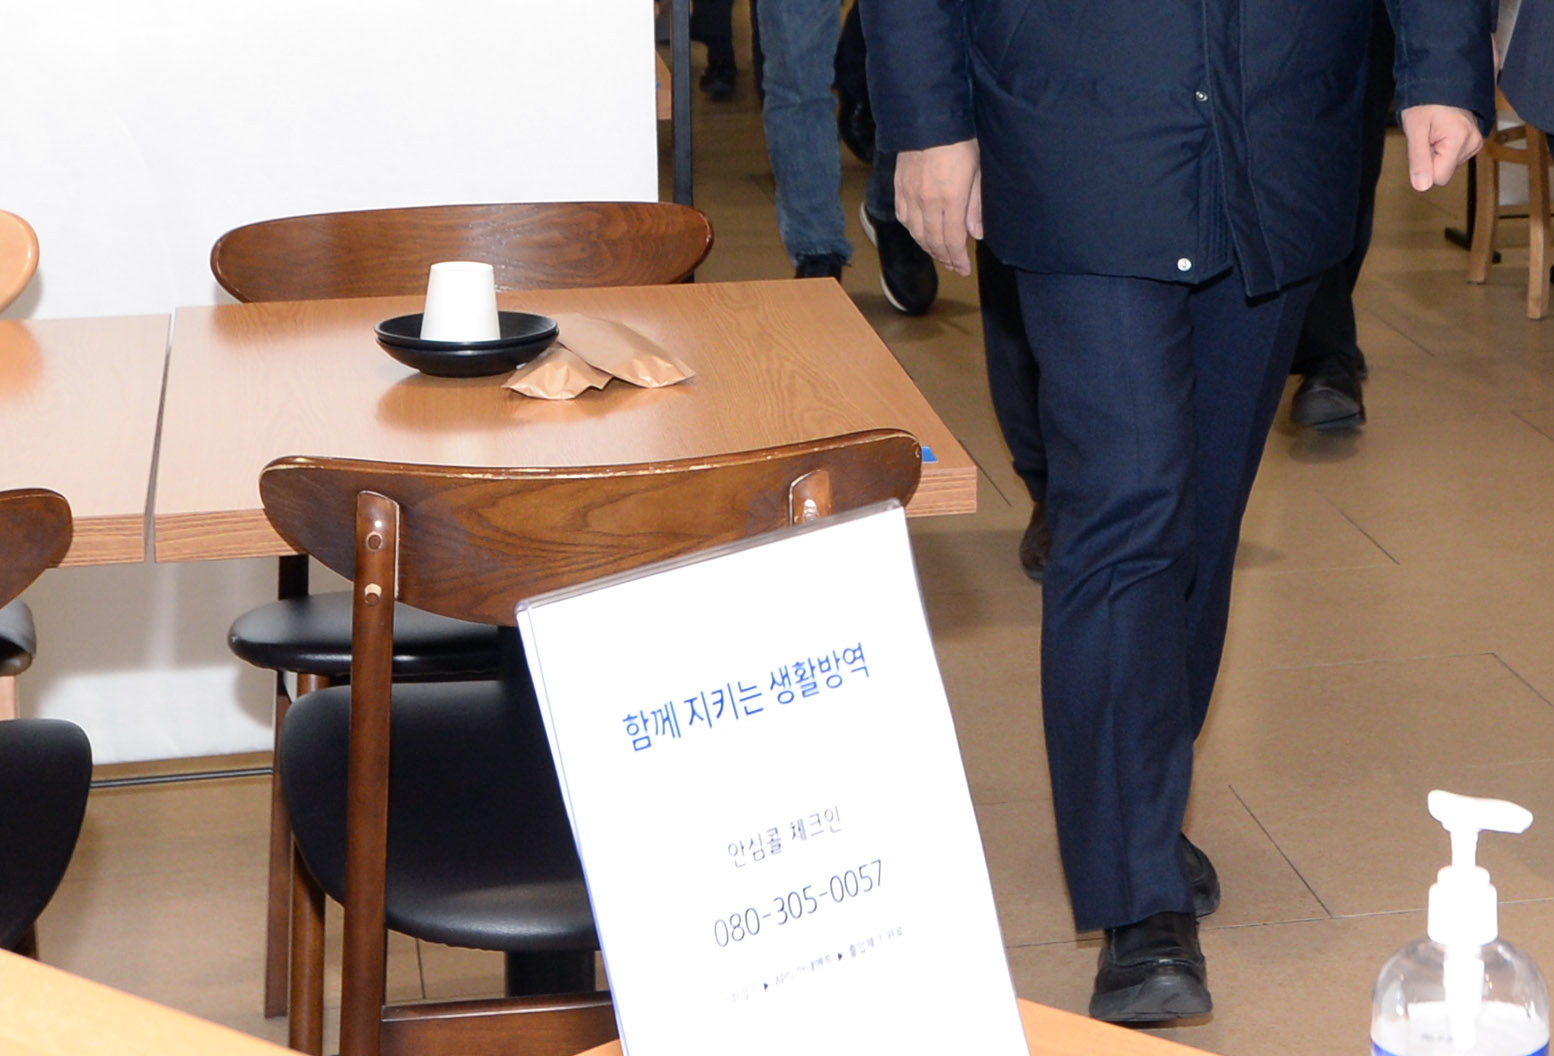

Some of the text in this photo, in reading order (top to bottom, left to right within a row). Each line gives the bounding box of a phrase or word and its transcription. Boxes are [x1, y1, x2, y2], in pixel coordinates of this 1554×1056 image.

[622, 642, 869, 751] 함께 지키는 생활방역
[728, 805, 842, 868] 안심콜 체크인
[714, 859, 882, 947] 080-305-0057
